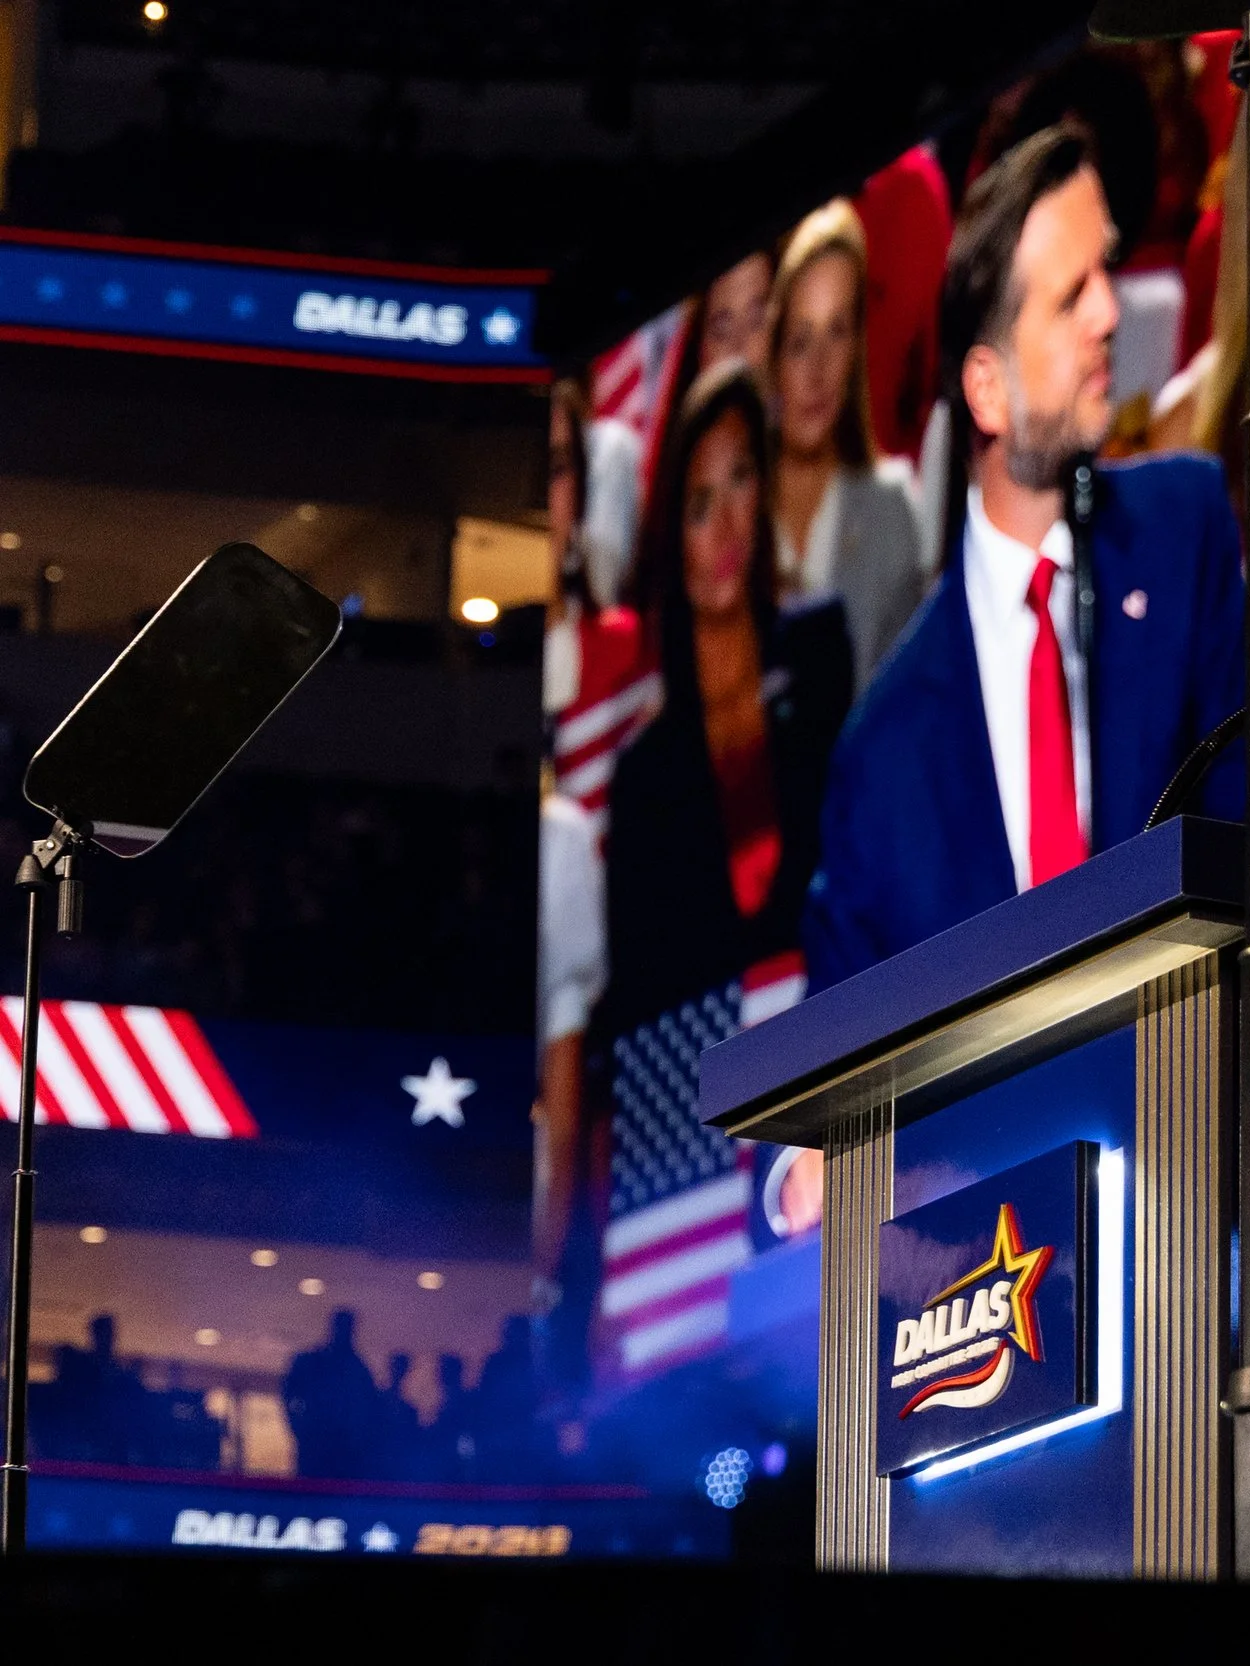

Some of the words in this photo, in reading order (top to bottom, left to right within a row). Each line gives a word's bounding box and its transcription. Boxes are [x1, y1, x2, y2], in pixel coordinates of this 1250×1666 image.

[294, 292, 466, 345] DALLAS
[894, 1280, 1012, 1367] DALLAS
[173, 1509, 345, 1552] DALLAS
